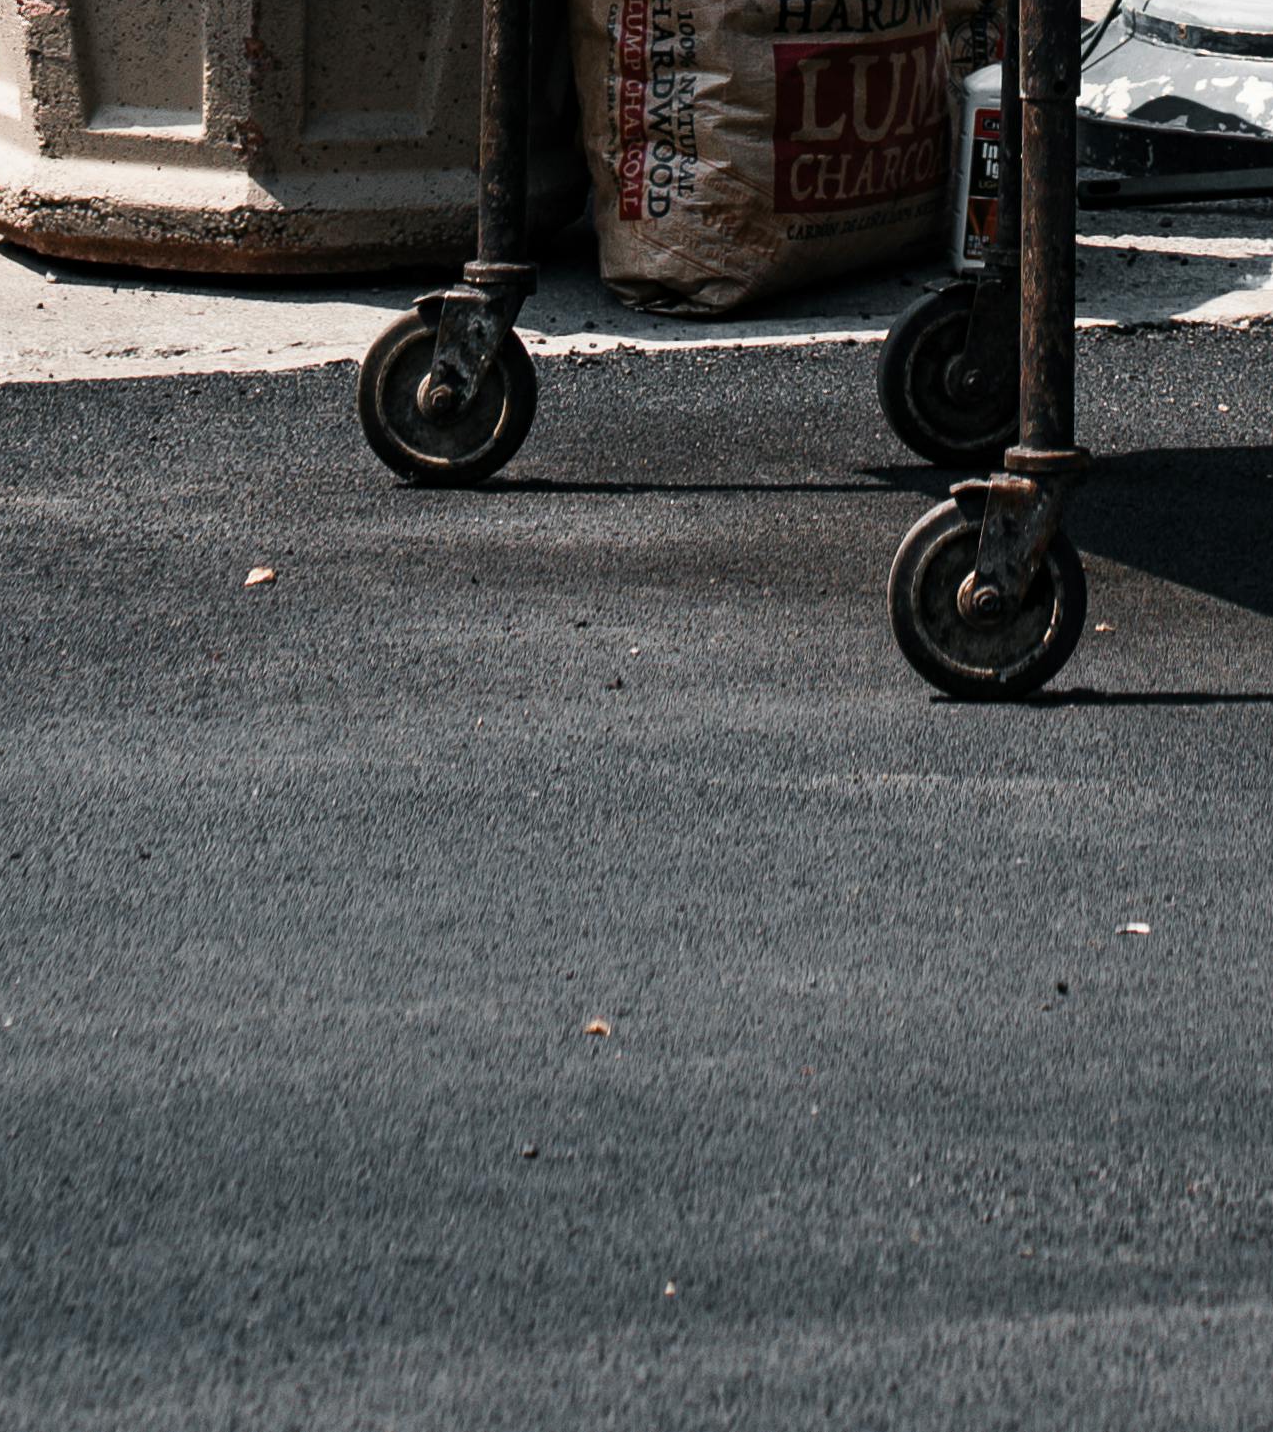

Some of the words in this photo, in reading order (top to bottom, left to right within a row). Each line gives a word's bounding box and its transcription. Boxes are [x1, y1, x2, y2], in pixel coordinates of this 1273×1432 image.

[625, 0, 645, 71] LUMP
[677, 11, 696, 68] 100%
[622, 79, 645, 216] CHARCOAL
[677, 74, 698, 198] NATURAL
